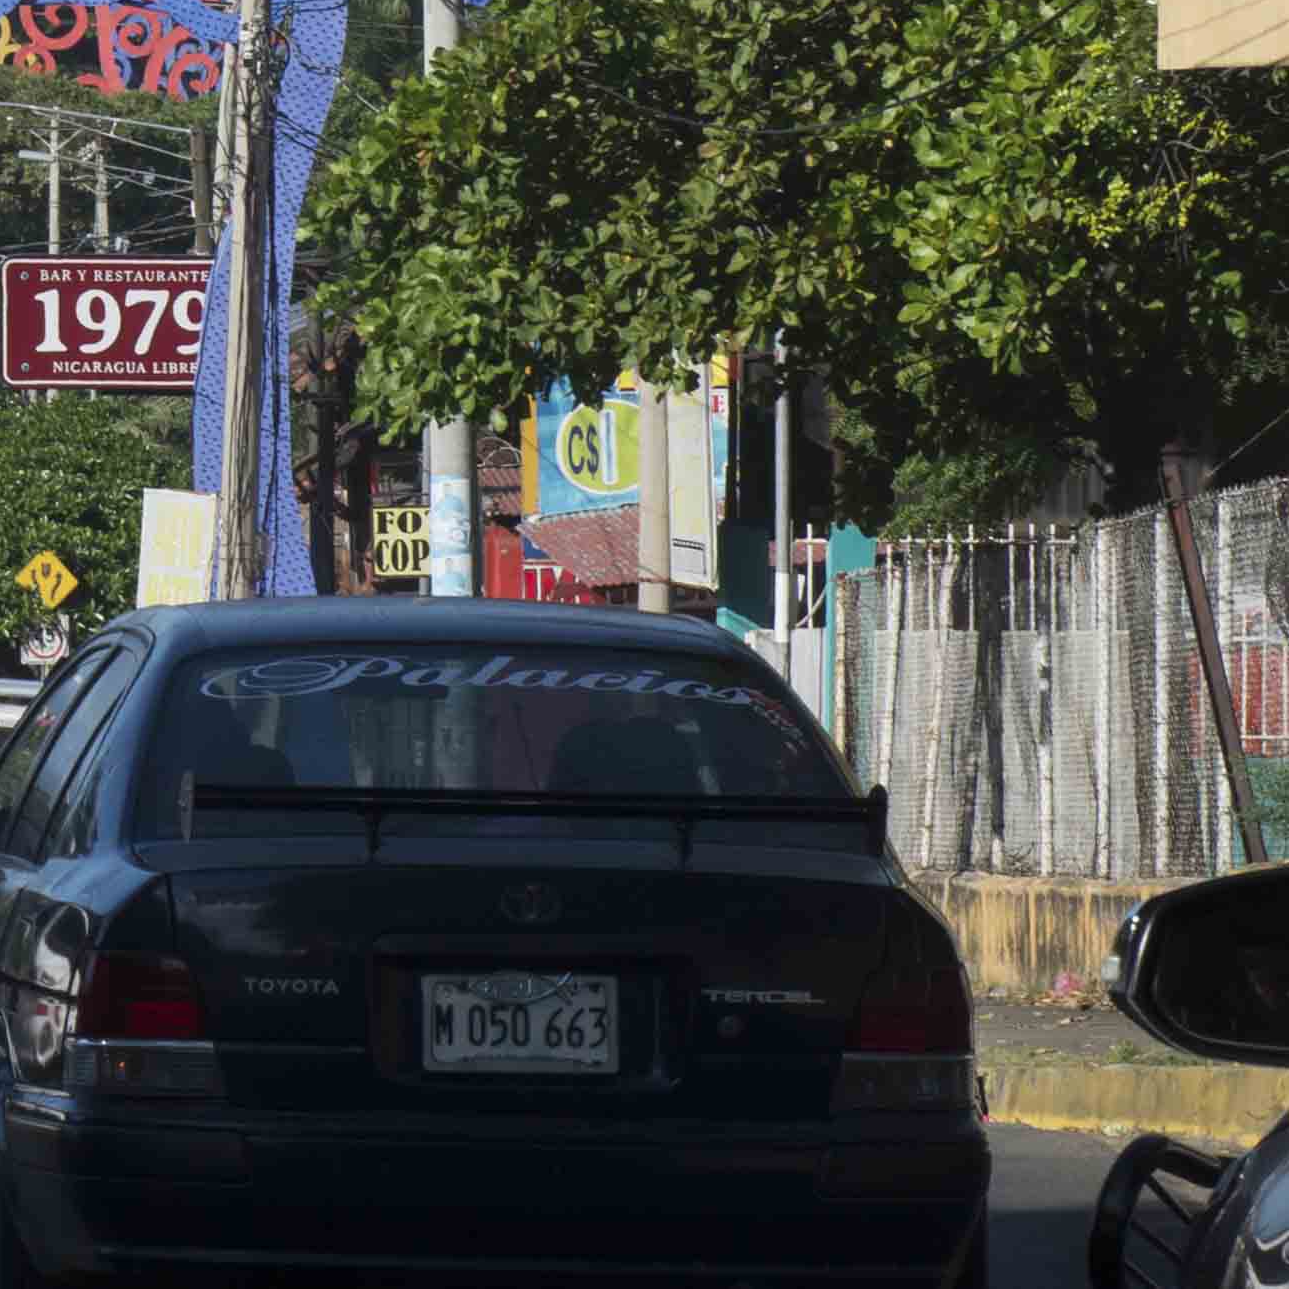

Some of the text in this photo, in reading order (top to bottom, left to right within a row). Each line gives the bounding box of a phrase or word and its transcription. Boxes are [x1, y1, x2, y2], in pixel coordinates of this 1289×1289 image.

[40, 270, 209, 282] BAR Y RESTAURANTE
[34, 289, 205, 355] 1979
[53, 362, 146, 374] NICARAGUA
[377, 510, 430, 534] FO
[200, 654, 752, 704] Palacios
[244, 977, 340, 995] TOYOTA
[435, 1004, 608, 1049] M 050 663
